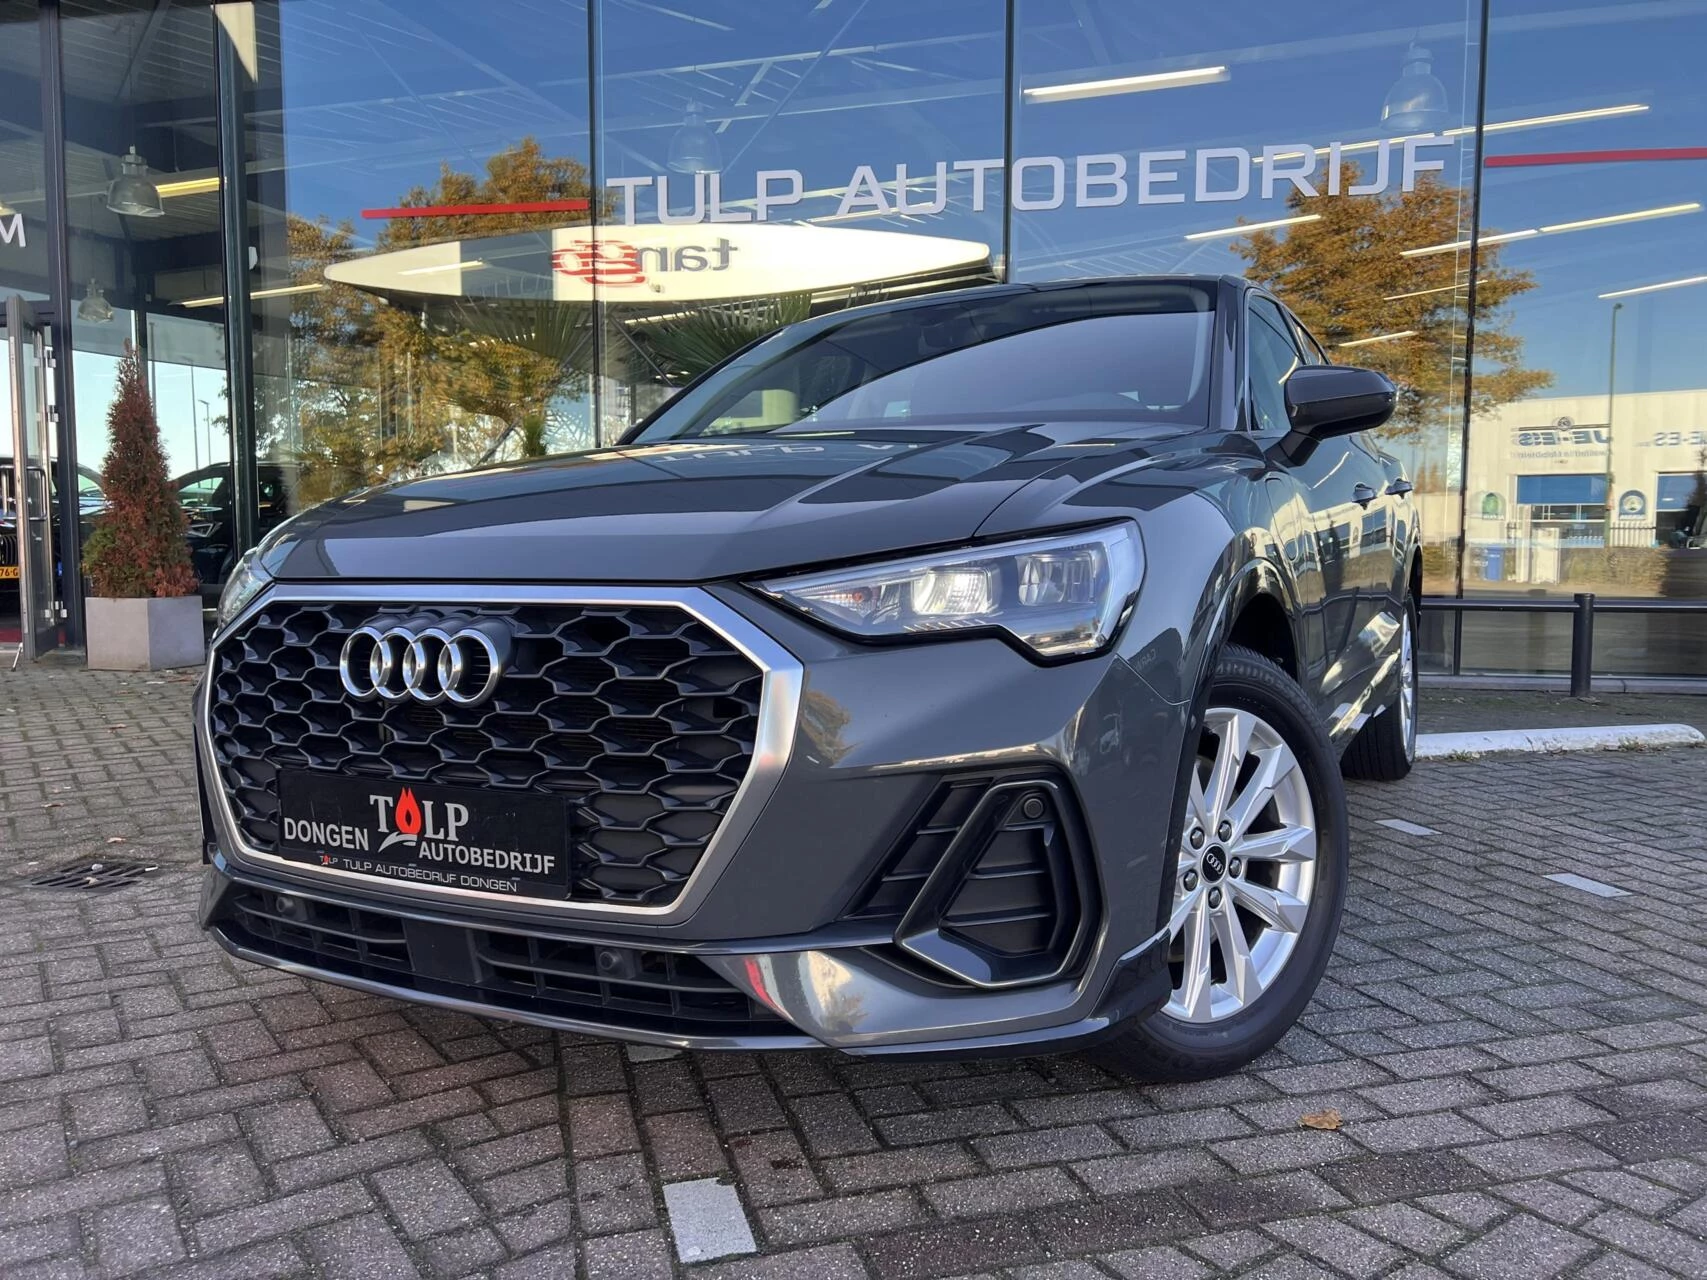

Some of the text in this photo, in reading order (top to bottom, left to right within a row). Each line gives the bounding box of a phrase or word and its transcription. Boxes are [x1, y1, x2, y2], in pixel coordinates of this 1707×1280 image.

[606, 136, 1455, 225] TULP AUTOBEDRIJF
[284, 816, 370, 851] DONGEN
[343, 857, 373, 871] TULP
[375, 863, 457, 884] AUTOBEDRIJF
[460, 875, 518, 893] DONGEN
[418, 840, 556, 875] AUTOBEDRIJF
